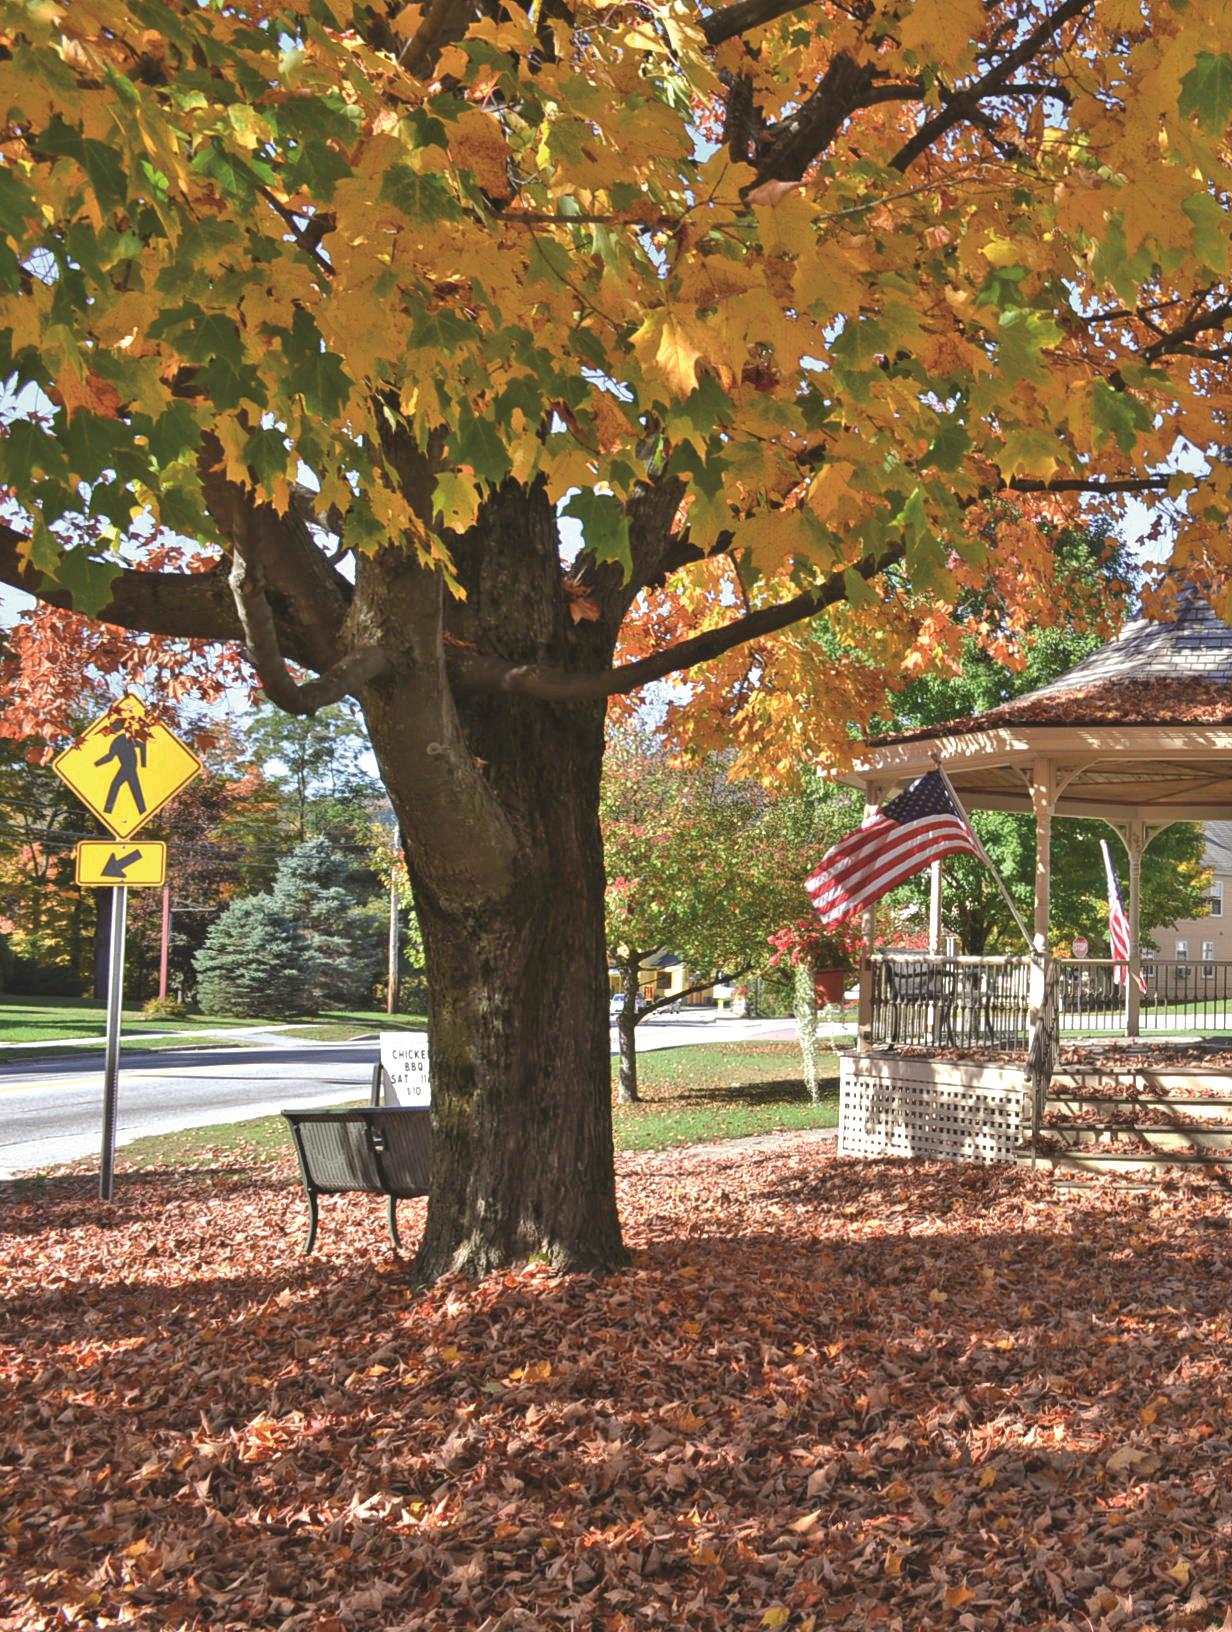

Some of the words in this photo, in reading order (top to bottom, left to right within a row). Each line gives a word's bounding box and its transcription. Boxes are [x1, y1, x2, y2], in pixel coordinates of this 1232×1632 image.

[392, 1050, 428, 1059] CHICKE
[405, 1062, 423, 1071] BBQ
[391, 1074, 408, 1084] SAT
